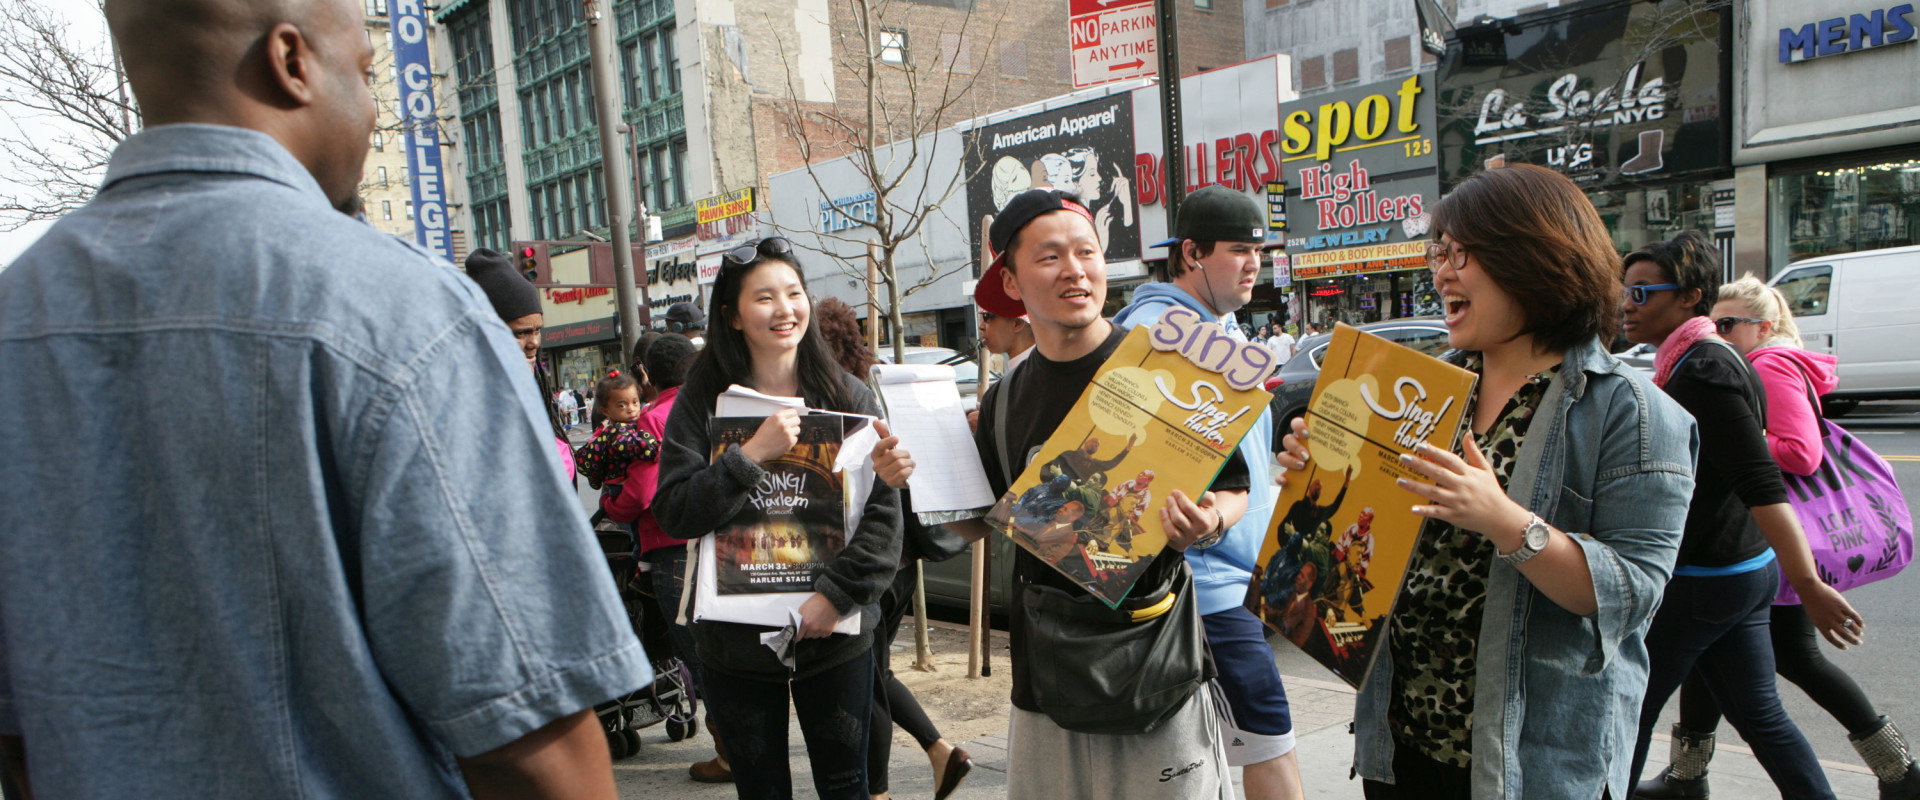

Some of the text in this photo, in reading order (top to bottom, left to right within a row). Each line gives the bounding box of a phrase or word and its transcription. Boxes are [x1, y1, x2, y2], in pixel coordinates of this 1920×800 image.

[397, 0, 423, 44] RO
[1073, 14, 1155, 45] NO PARKIN
[1778, 3, 1915, 63] MENS
[1089, 39, 1155, 63] ANYTIME
[1474, 63, 1667, 136] La Scala
[1281, 74, 1423, 160] spot
[1613, 105, 1665, 124] NYC
[992, 108, 1115, 150] American Apparel
[404, 62, 447, 256] COLLEGE
[1404, 138, 1432, 158] 125
[1300, 158, 1370, 201] High
[699, 199, 750, 221] PAWN SHOP
[706, 192, 742, 207] FAST CASH
[1317, 190, 1423, 230] Rollers
[696, 220, 721, 240] CELL
[726, 213, 749, 234] CITY
[820, 201, 877, 232] PLACE
[1287, 237, 1306, 246] 252W
[1303, 227, 1392, 249] JEWELRY
[1301, 242, 1423, 264] TATTOO & BODY PIERCING
[700, 265, 720, 278] Hom
[1154, 310, 1271, 387] Sing
[1154, 375, 1250, 429] Sing!
[1360, 376, 1454, 436] Sing!
[1183, 411, 1225, 445] Harlem
[1394, 422, 1431, 452] Harl
[756, 471, 806, 495] SING!
[749, 490, 809, 510] Harlem
[1817, 507, 1862, 533] LOVE
[1828, 525, 1869, 553] PINK
[740, 563, 775, 571] MARCH
[750, 575, 812, 584] HARLEM STAGE
